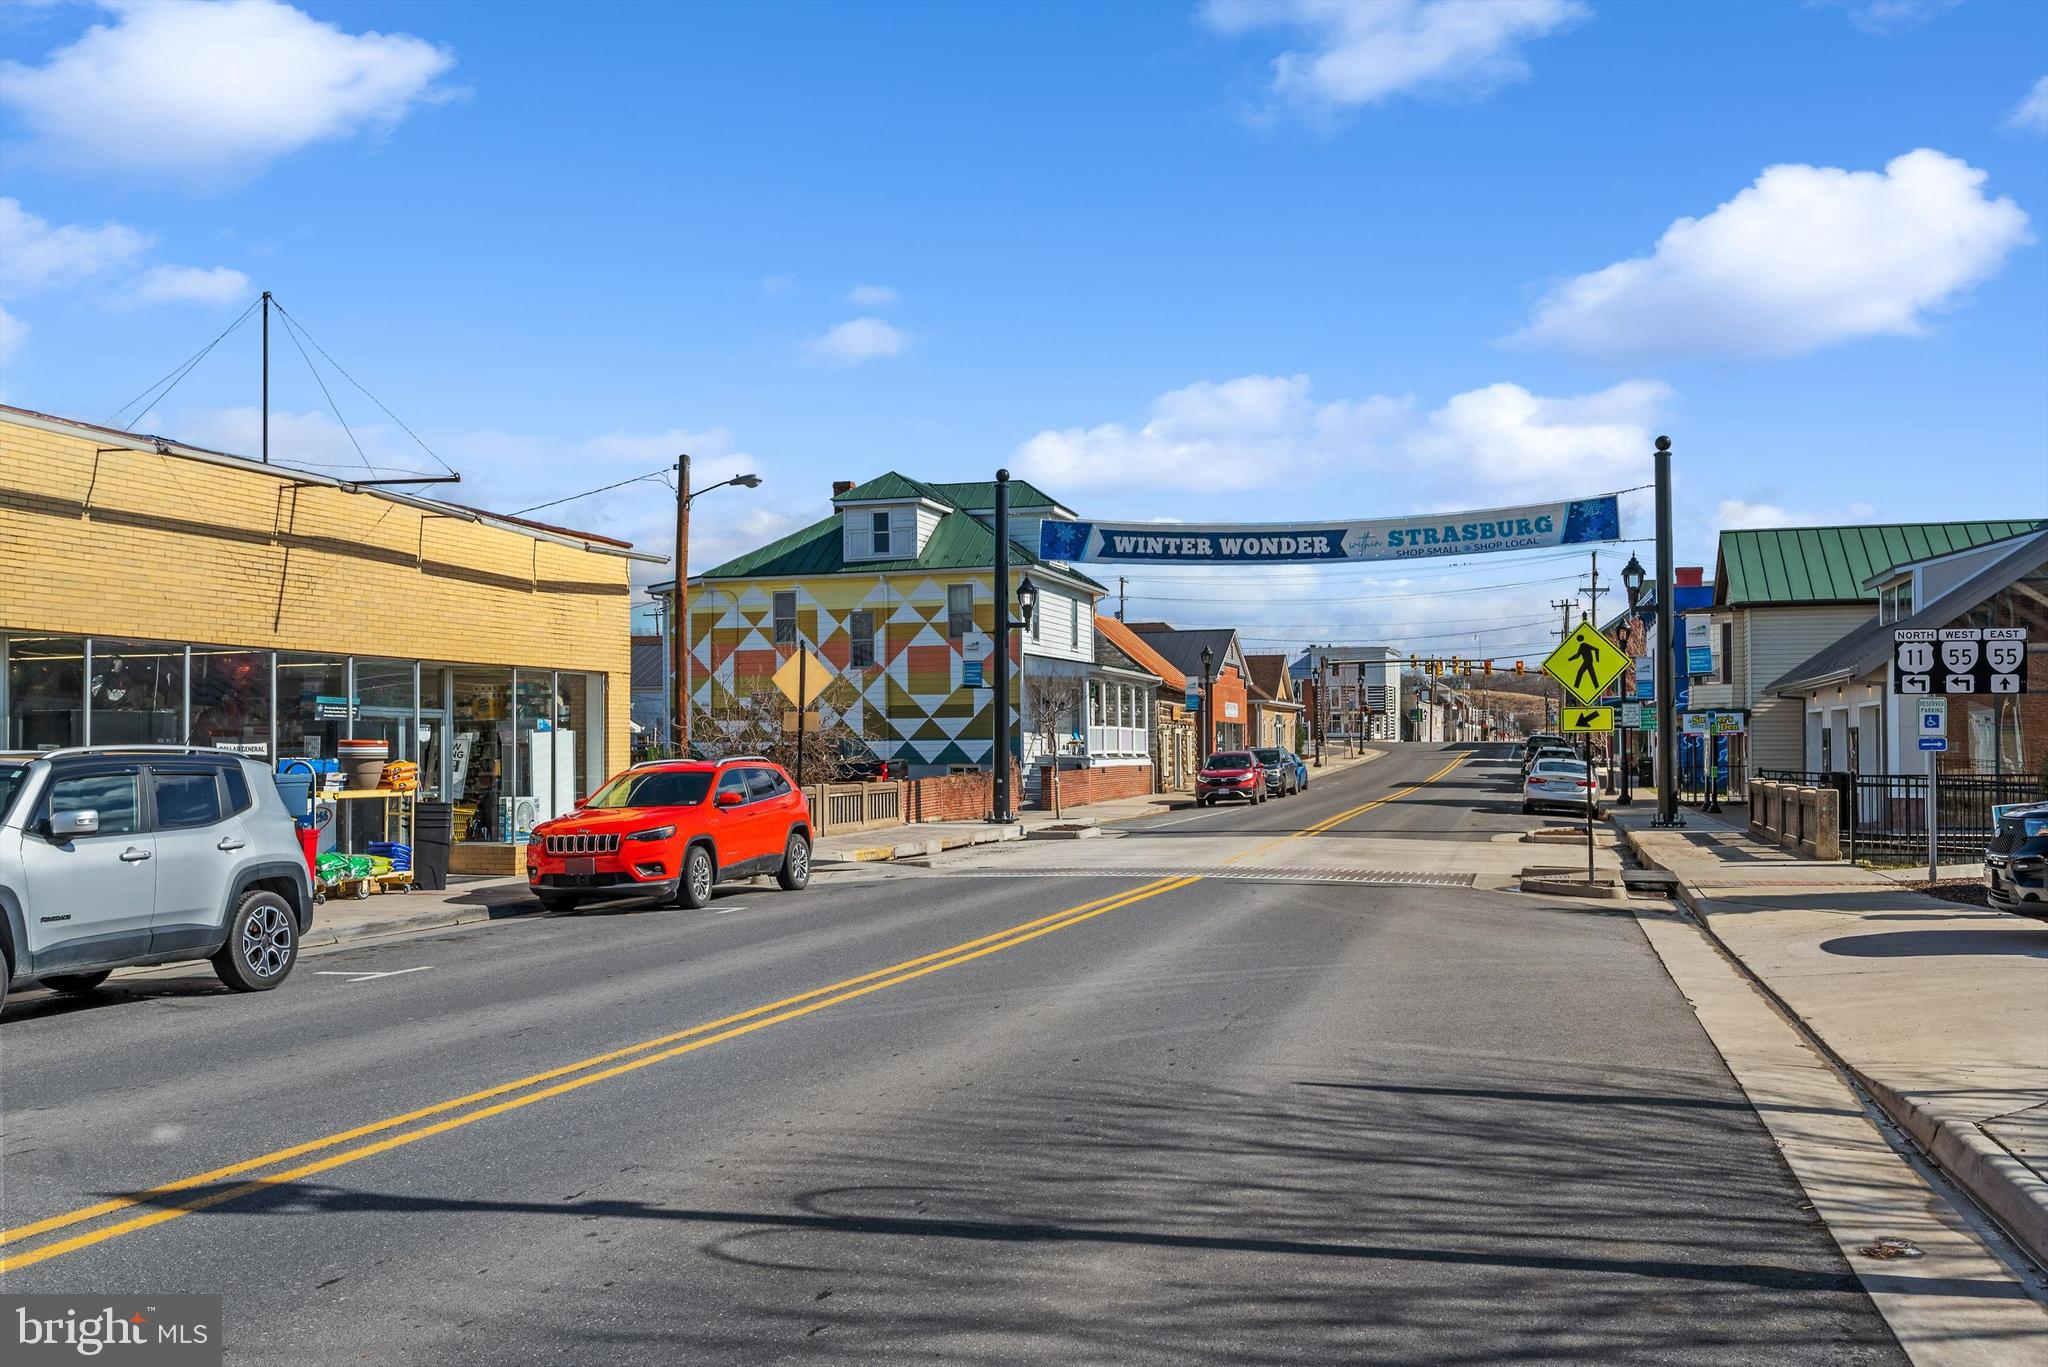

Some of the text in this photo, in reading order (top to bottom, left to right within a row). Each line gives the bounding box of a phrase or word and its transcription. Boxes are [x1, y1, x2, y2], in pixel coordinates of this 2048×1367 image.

[1388, 515, 1553, 547] STRASBURG
[1113, 535, 1330, 556] WINTER WONDER
[1348, 530, 1383, 557] within
[1396, 537, 1540, 558] SHOP SMALL SHOP LOCAL
[1897, 631, 1934, 640] NORTH
[1945, 630, 1975, 639] WEST
[1990, 630, 2019, 638] EAST
[1907, 649, 1923, 666] 11
[1949, 649, 1972, 666] 55
[1994, 648, 2017, 665] 55
[1720, 722, 1739, 731] Den
